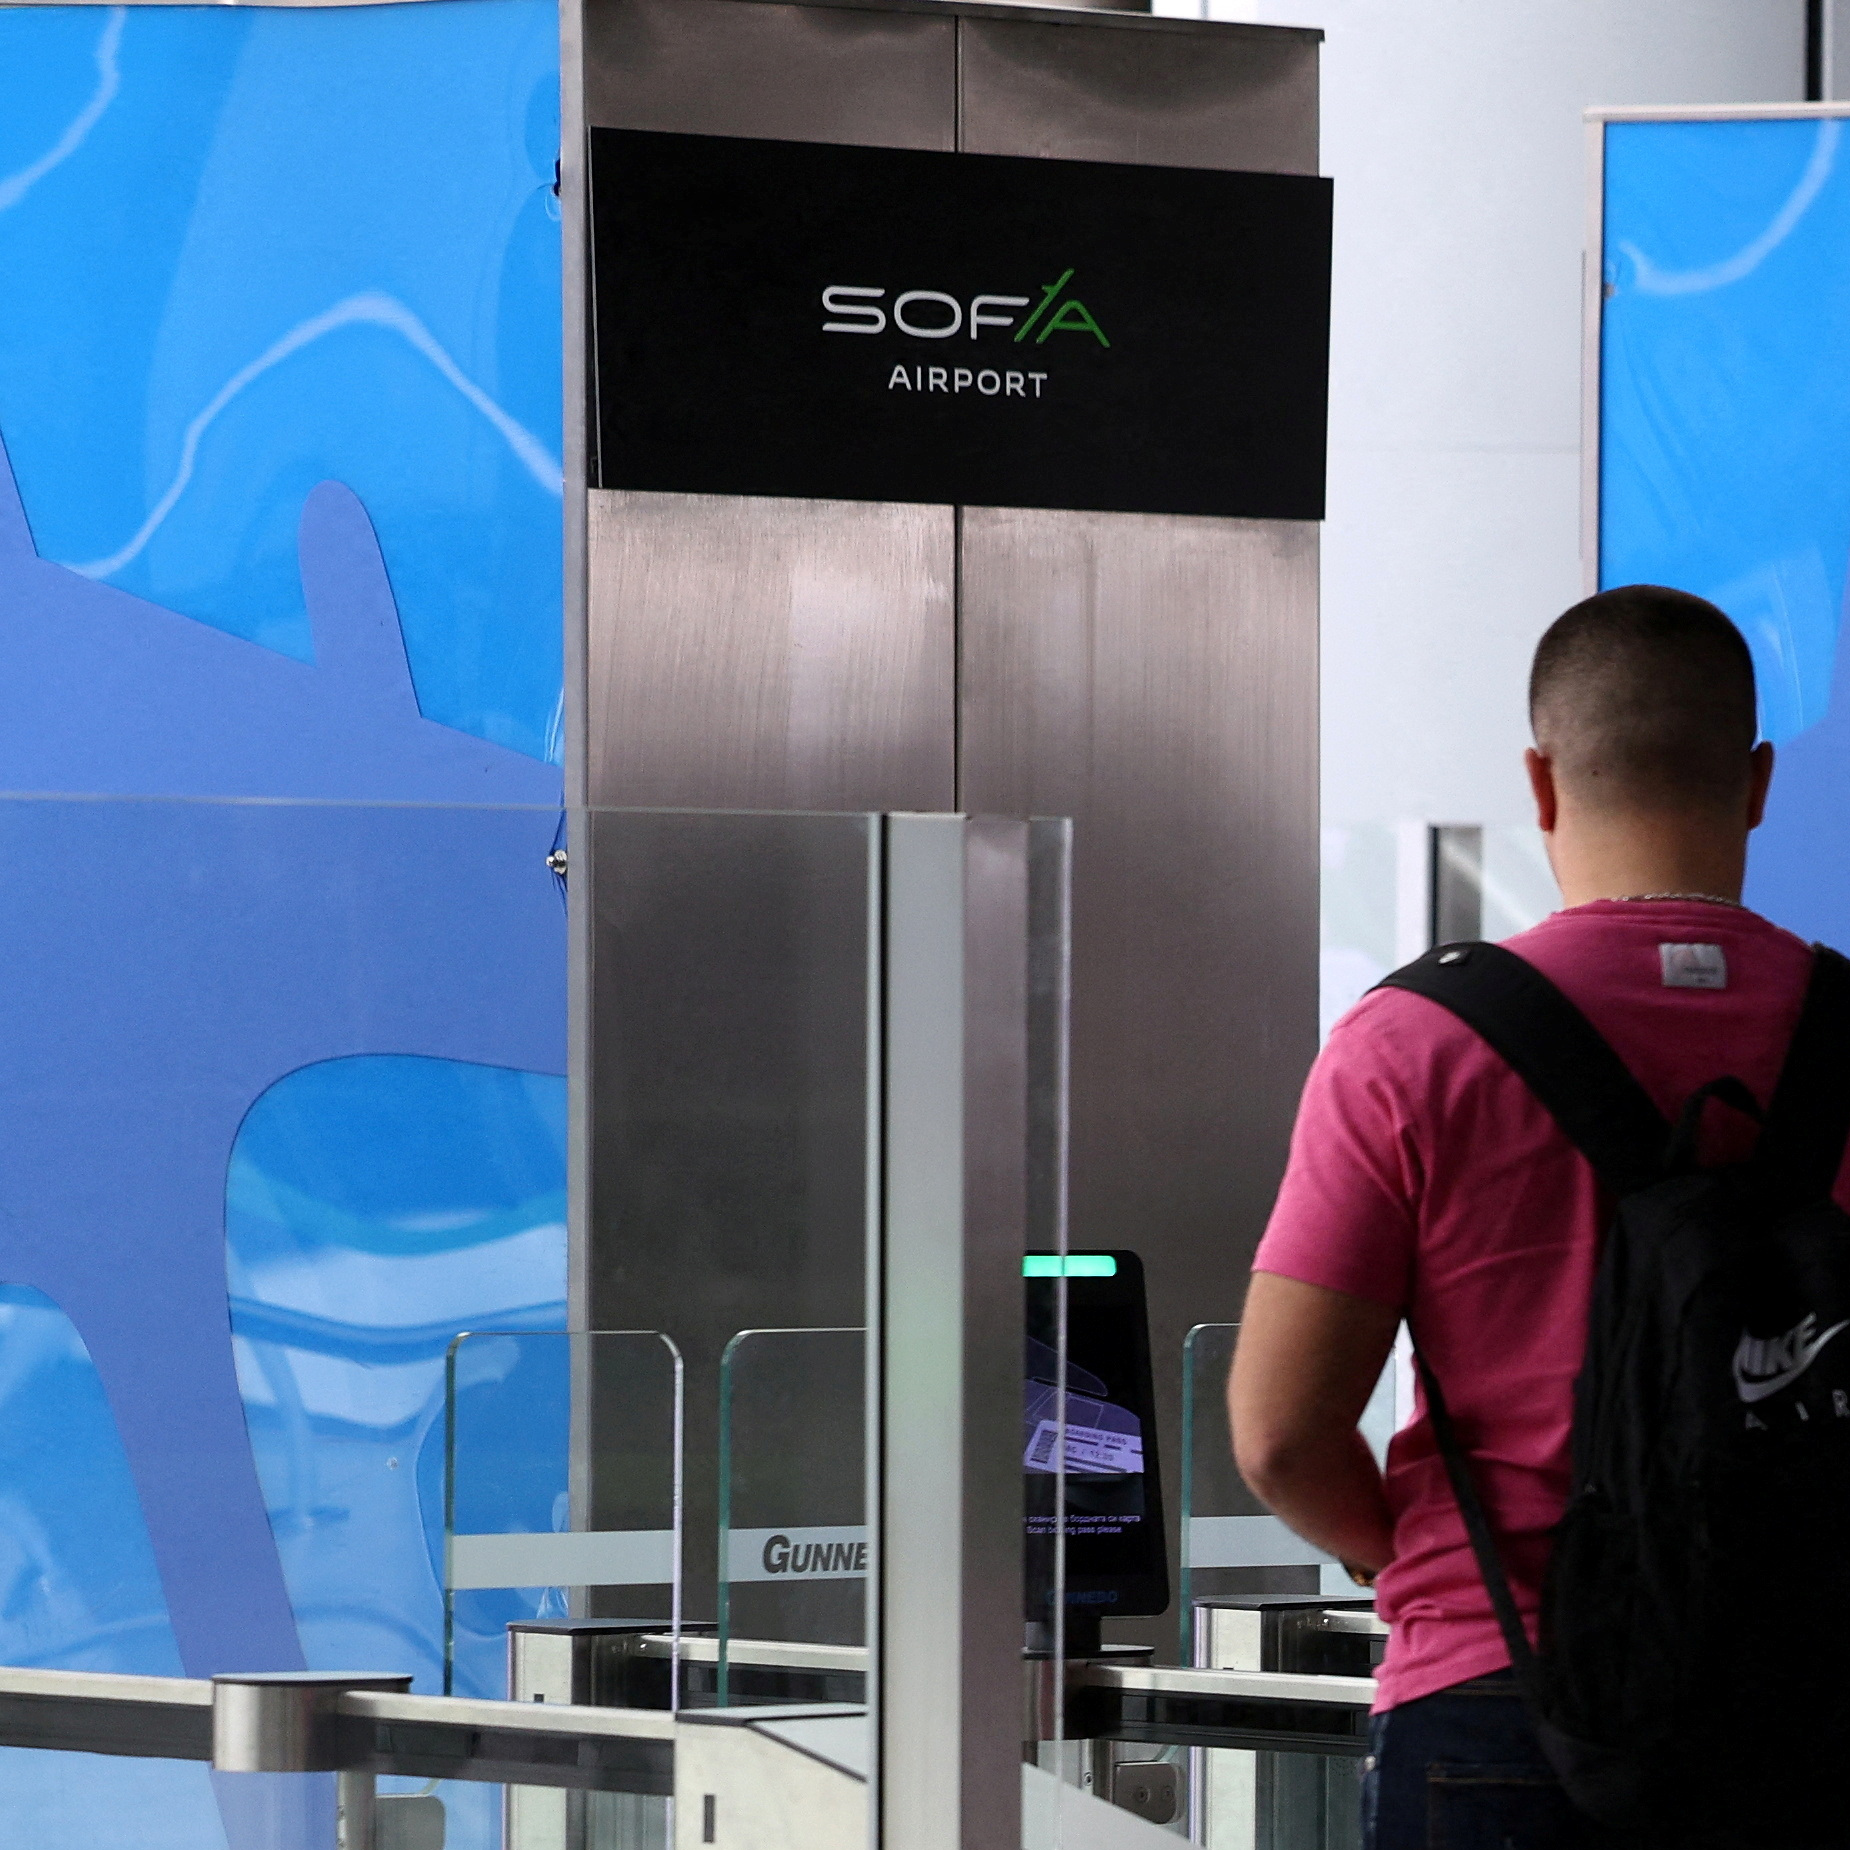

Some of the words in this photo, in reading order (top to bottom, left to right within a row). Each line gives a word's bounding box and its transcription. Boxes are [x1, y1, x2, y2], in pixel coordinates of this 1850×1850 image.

[821, 268, 1111, 348] SOFIA
[888, 364, 1048, 398] AIRPORT
[763, 1534, 867, 1574] GUNNE
